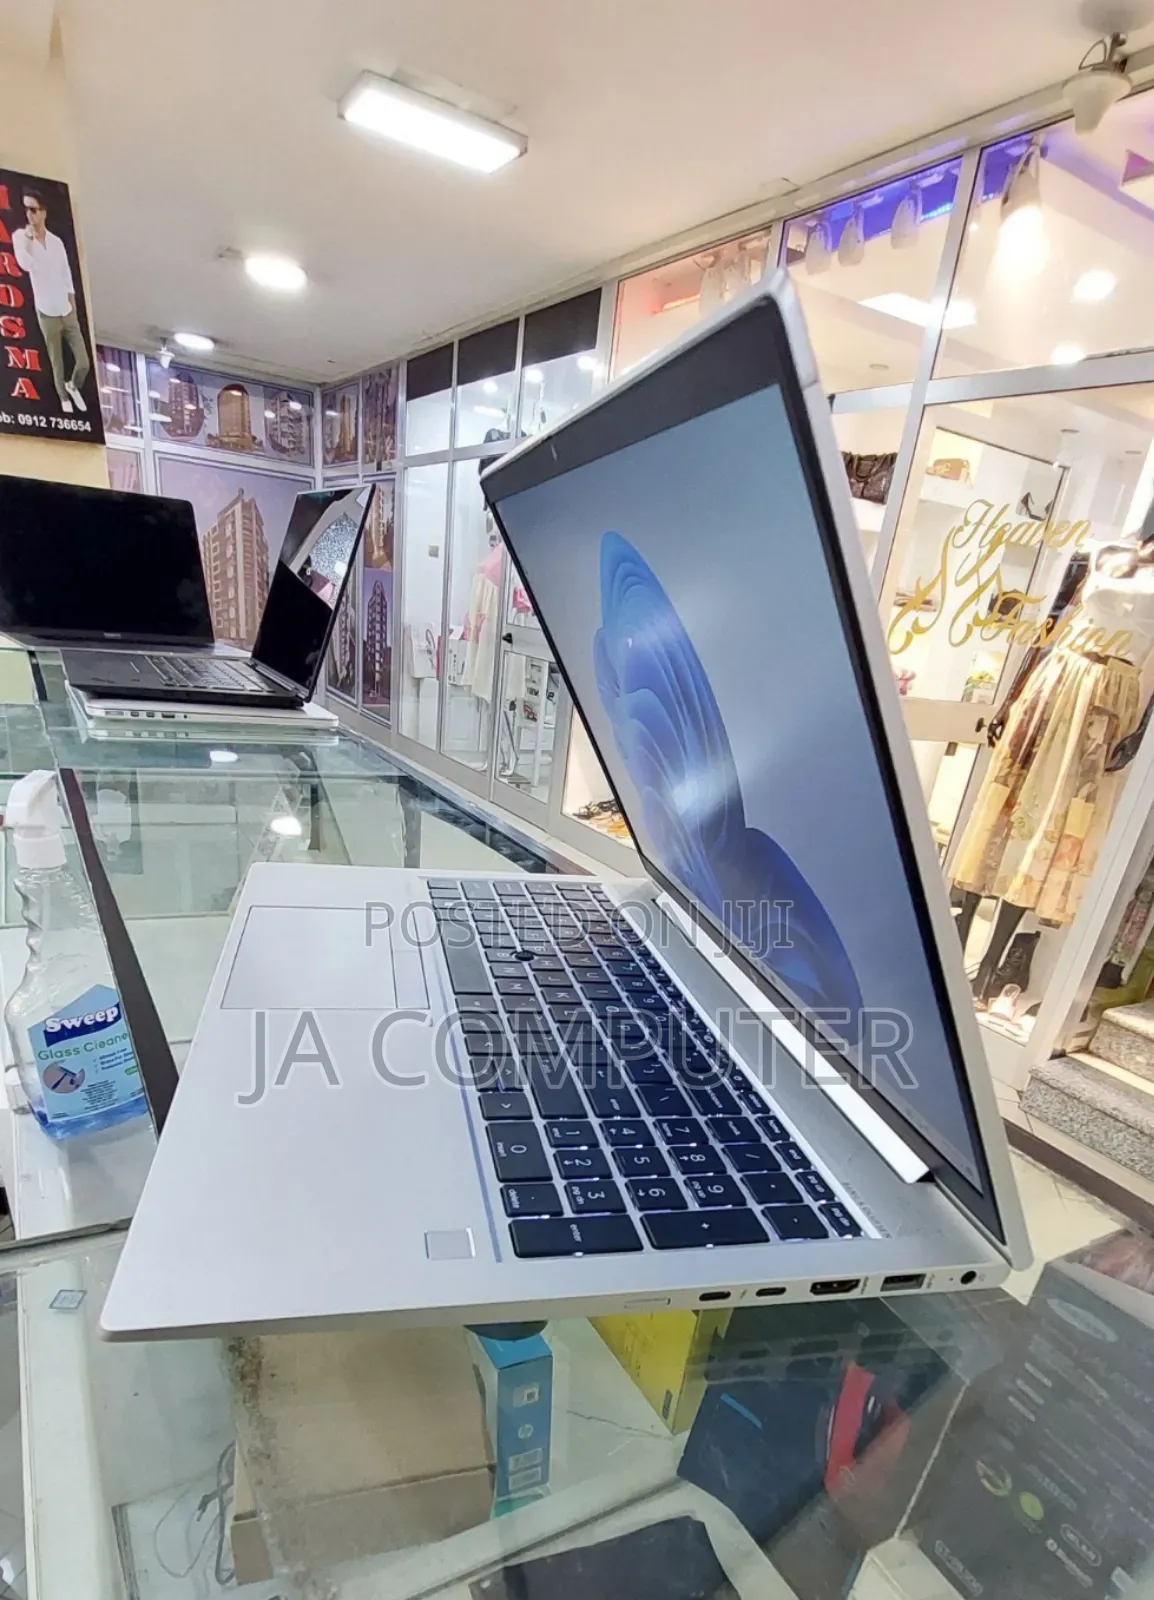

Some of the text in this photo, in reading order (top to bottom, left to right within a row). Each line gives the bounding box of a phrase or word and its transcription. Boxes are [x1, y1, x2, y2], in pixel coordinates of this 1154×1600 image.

[17, 413, 48, 428] 0912
[49, 416, 92, 433] 736654
[952, 499, 1092, 549] Heaven
[973, 593, 1134, 657] Fashion
[564, 1009, 577, 1017] L
[44, 1006, 119, 1033] Sweep
[37, 1045, 81, 1062] Glass
[83, 1032, 131, 1053] Cleane
[621, 1127, 636, 1136] 4
[674, 1126, 691, 1135] 7
[510, 1144, 528, 1154] 0
[574, 1157, 593, 1167] 2
[633, 1155, 651, 1165] 5
[690, 1153, 706, 1163] 8
[571, 1185, 582, 1196] pg
[648, 1187, 666, 1198] 6
[707, 1184, 725, 1194] 9
[588, 1191, 606, 1200] 3
[569, 1223, 583, 1243] enter
